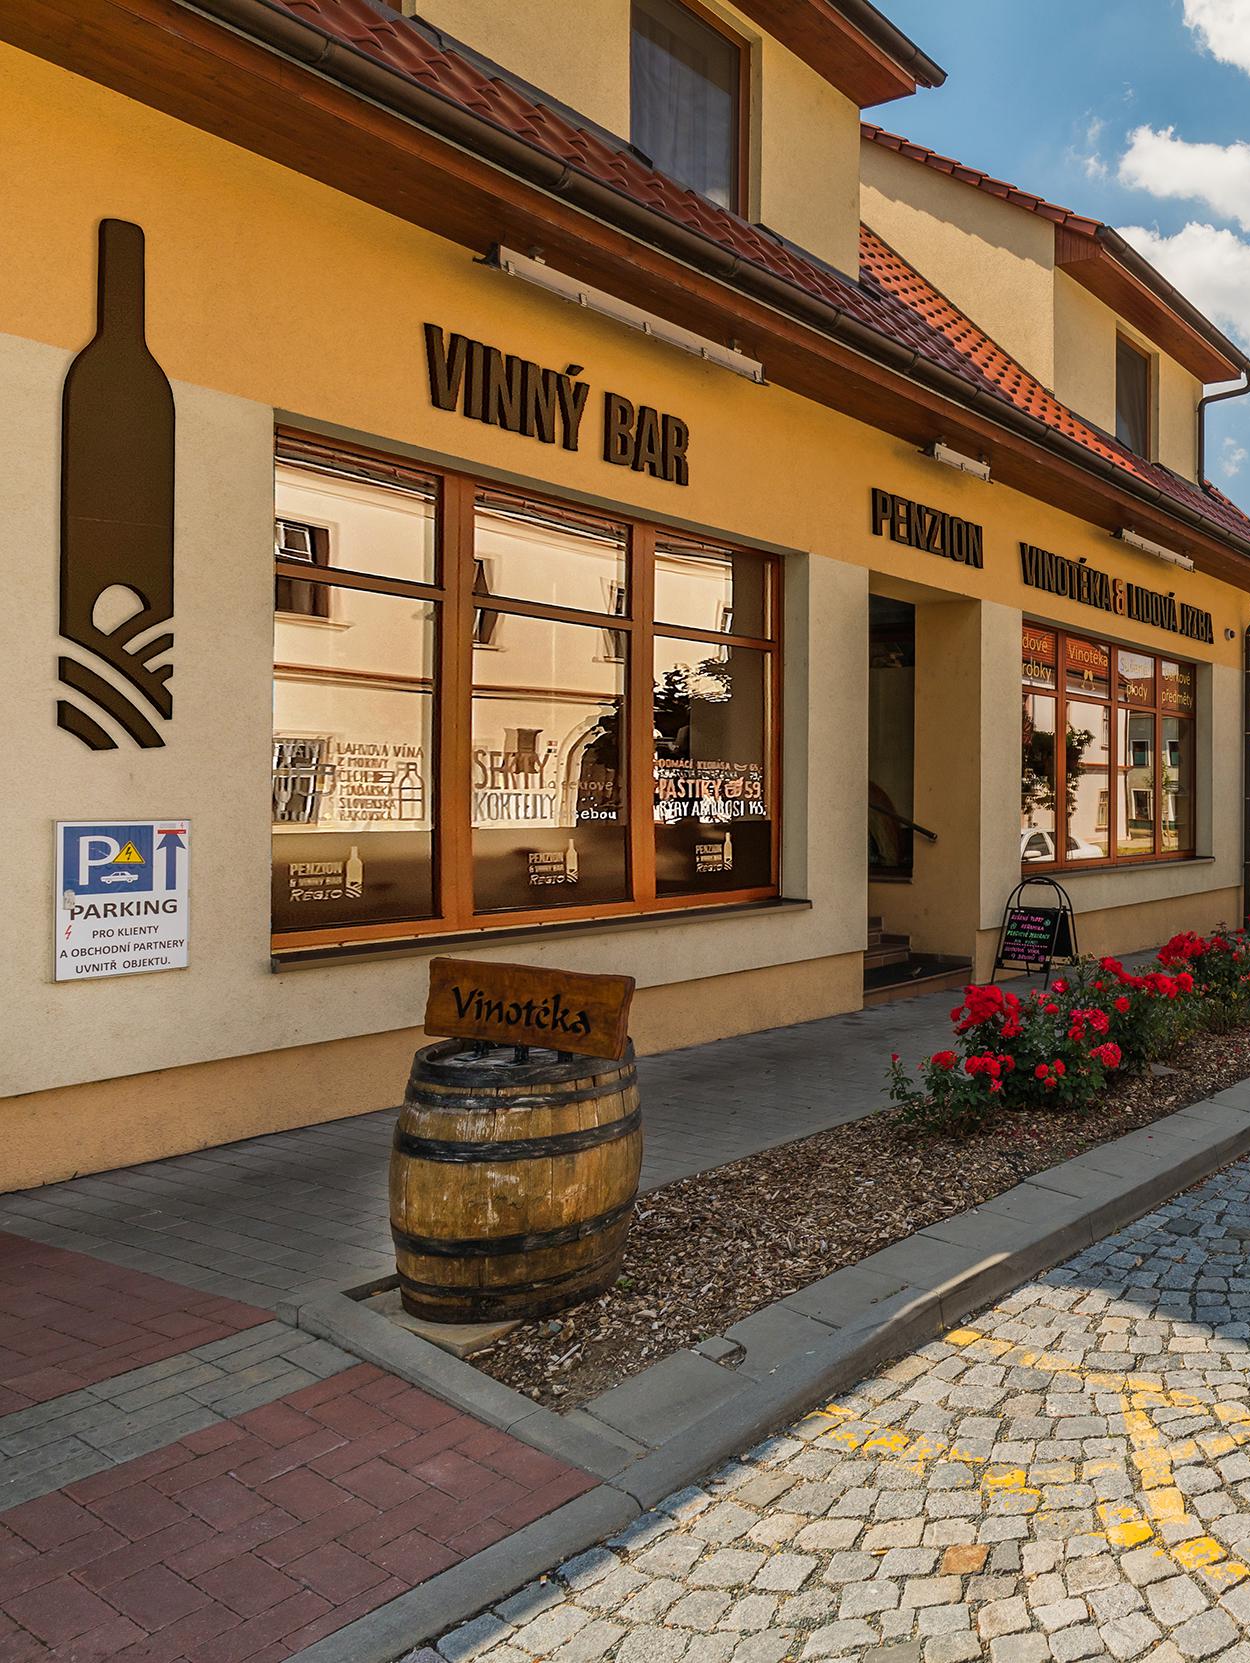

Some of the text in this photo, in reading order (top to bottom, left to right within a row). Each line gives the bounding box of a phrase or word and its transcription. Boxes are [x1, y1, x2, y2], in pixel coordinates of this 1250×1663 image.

[424, 322, 689, 486] VINNÝ BAR
[871, 488, 984, 569] PENZION
[1018, 541, 1215, 645] VINOTÉKA & LIDOVÁ JIZBA
[1022, 633, 1048, 653] dové
[1068, 643, 1108, 667] Vinotéka
[1022, 660, 1052, 682] robky
[393, 743, 424, 758] VÍNA
[473, 749, 550, 790] SEKTY
[660, 778, 722, 800] PAŠTIKY
[473, 792, 557, 822] KOKTEJLY
[70, 898, 178, 920] PARKING
[92, 925, 160, 938] PRO KLIENTY
[60, 939, 185, 958] A OBCHODNÍ PARTNERY
[76, 956, 171, 974] UVNITŘ OBJEKTU.
[452, 986, 592, 1034] Vinotéka
